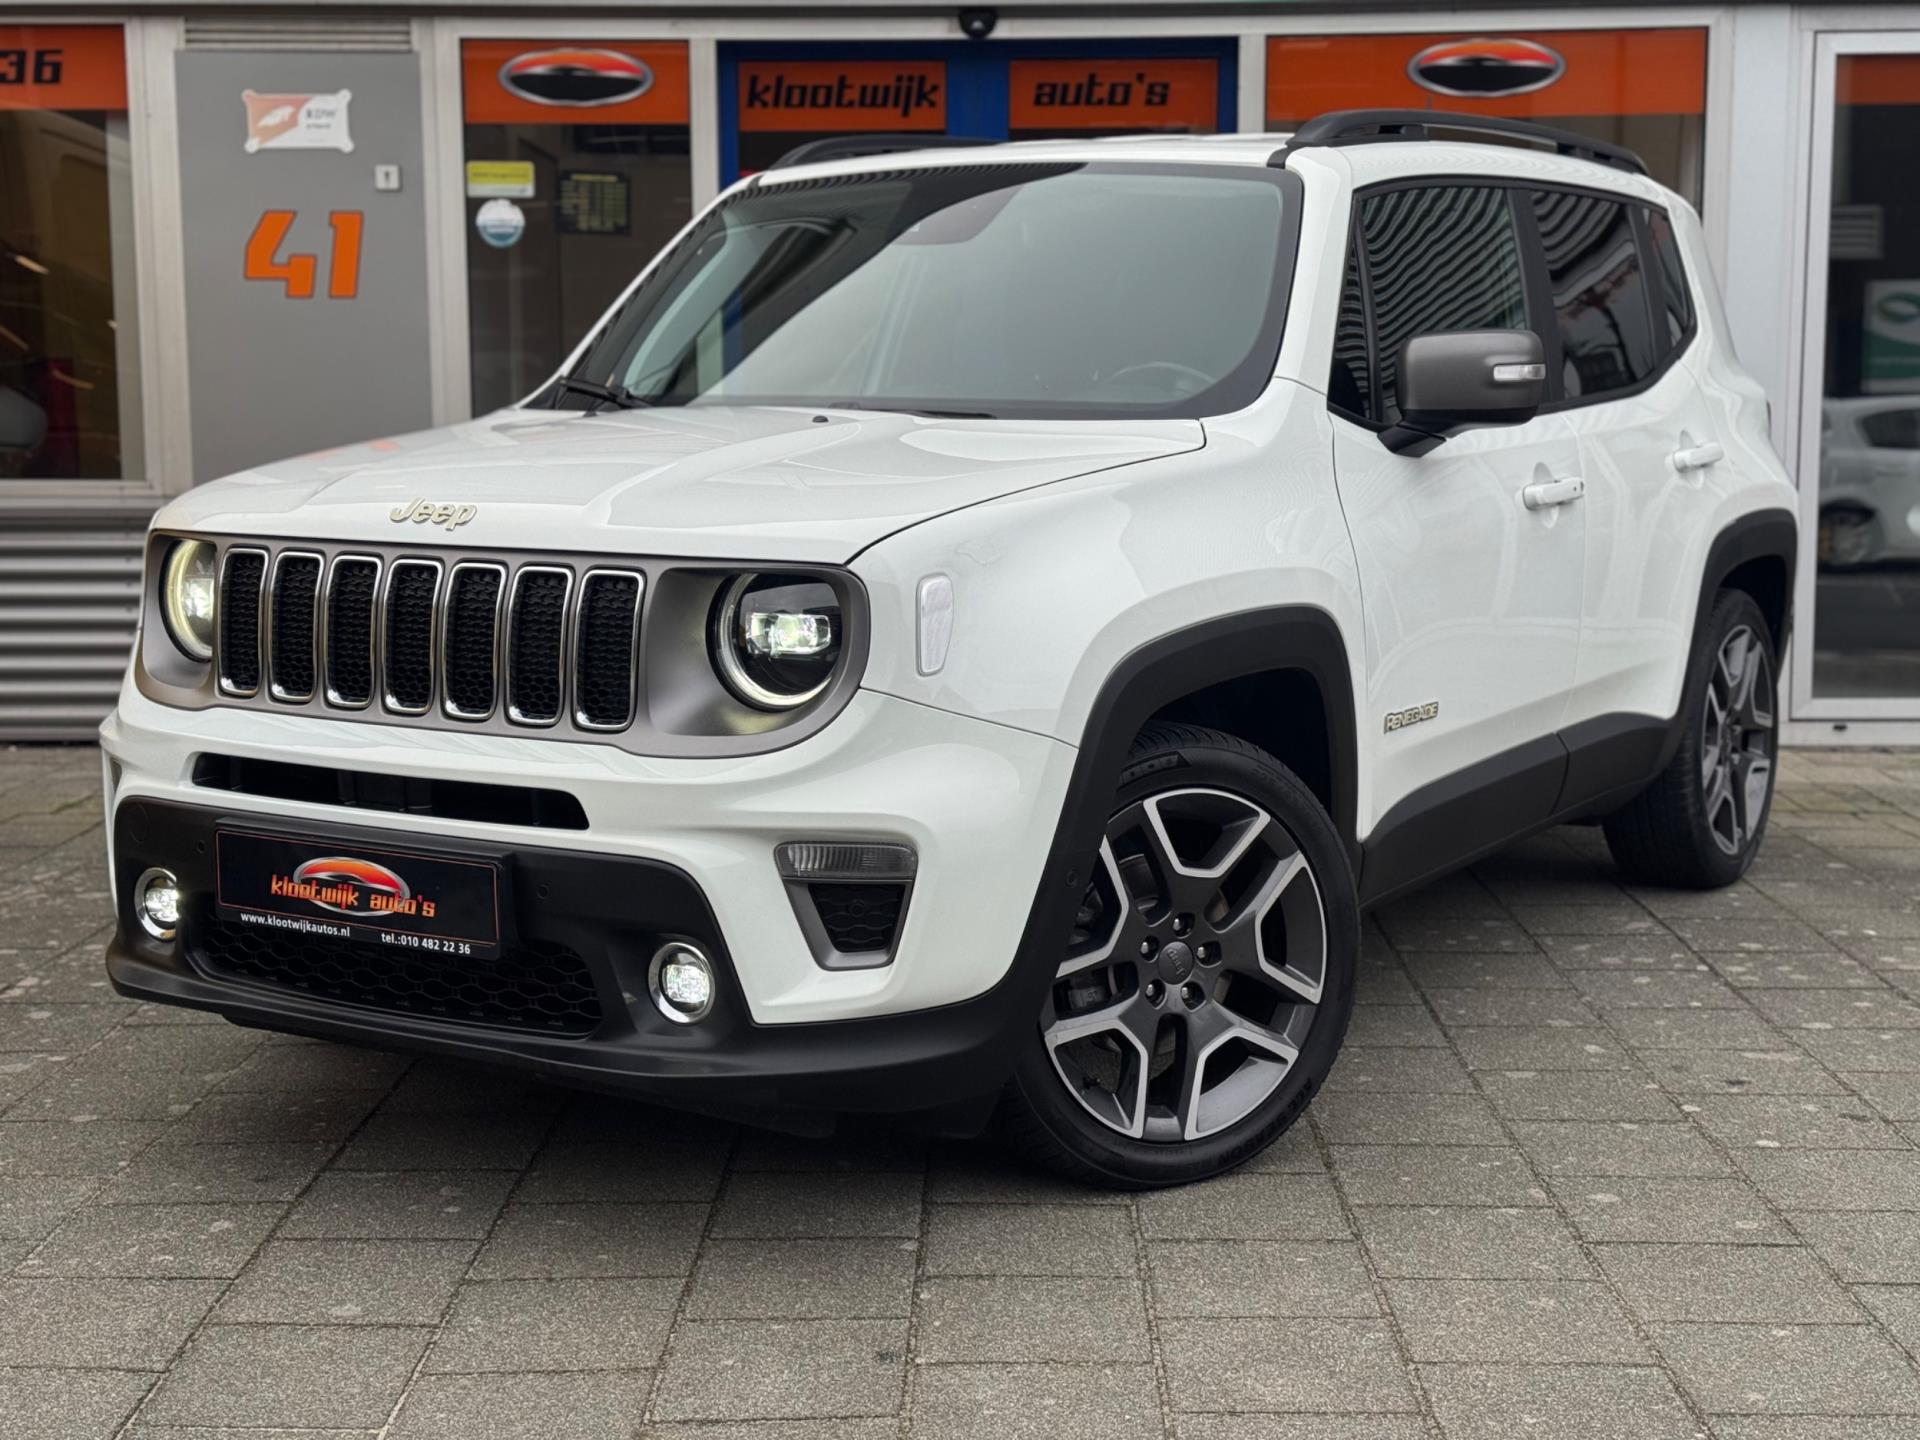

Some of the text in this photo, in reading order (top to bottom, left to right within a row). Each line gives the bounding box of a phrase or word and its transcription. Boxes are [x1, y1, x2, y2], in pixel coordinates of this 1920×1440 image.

[0, 49, 63, 84] 36
[746, 72, 1170, 118] klootwijk auto's
[244, 209, 363, 299] 41
[389, 496, 477, 532] Jeep
[1384, 701, 1439, 734] RENEGADE
[271, 874, 436, 917] klootwijk auto's
[240, 912, 351, 937] www.klootwijkautos.nl
[381, 932, 471, 955] tel.:010 482 22 36
